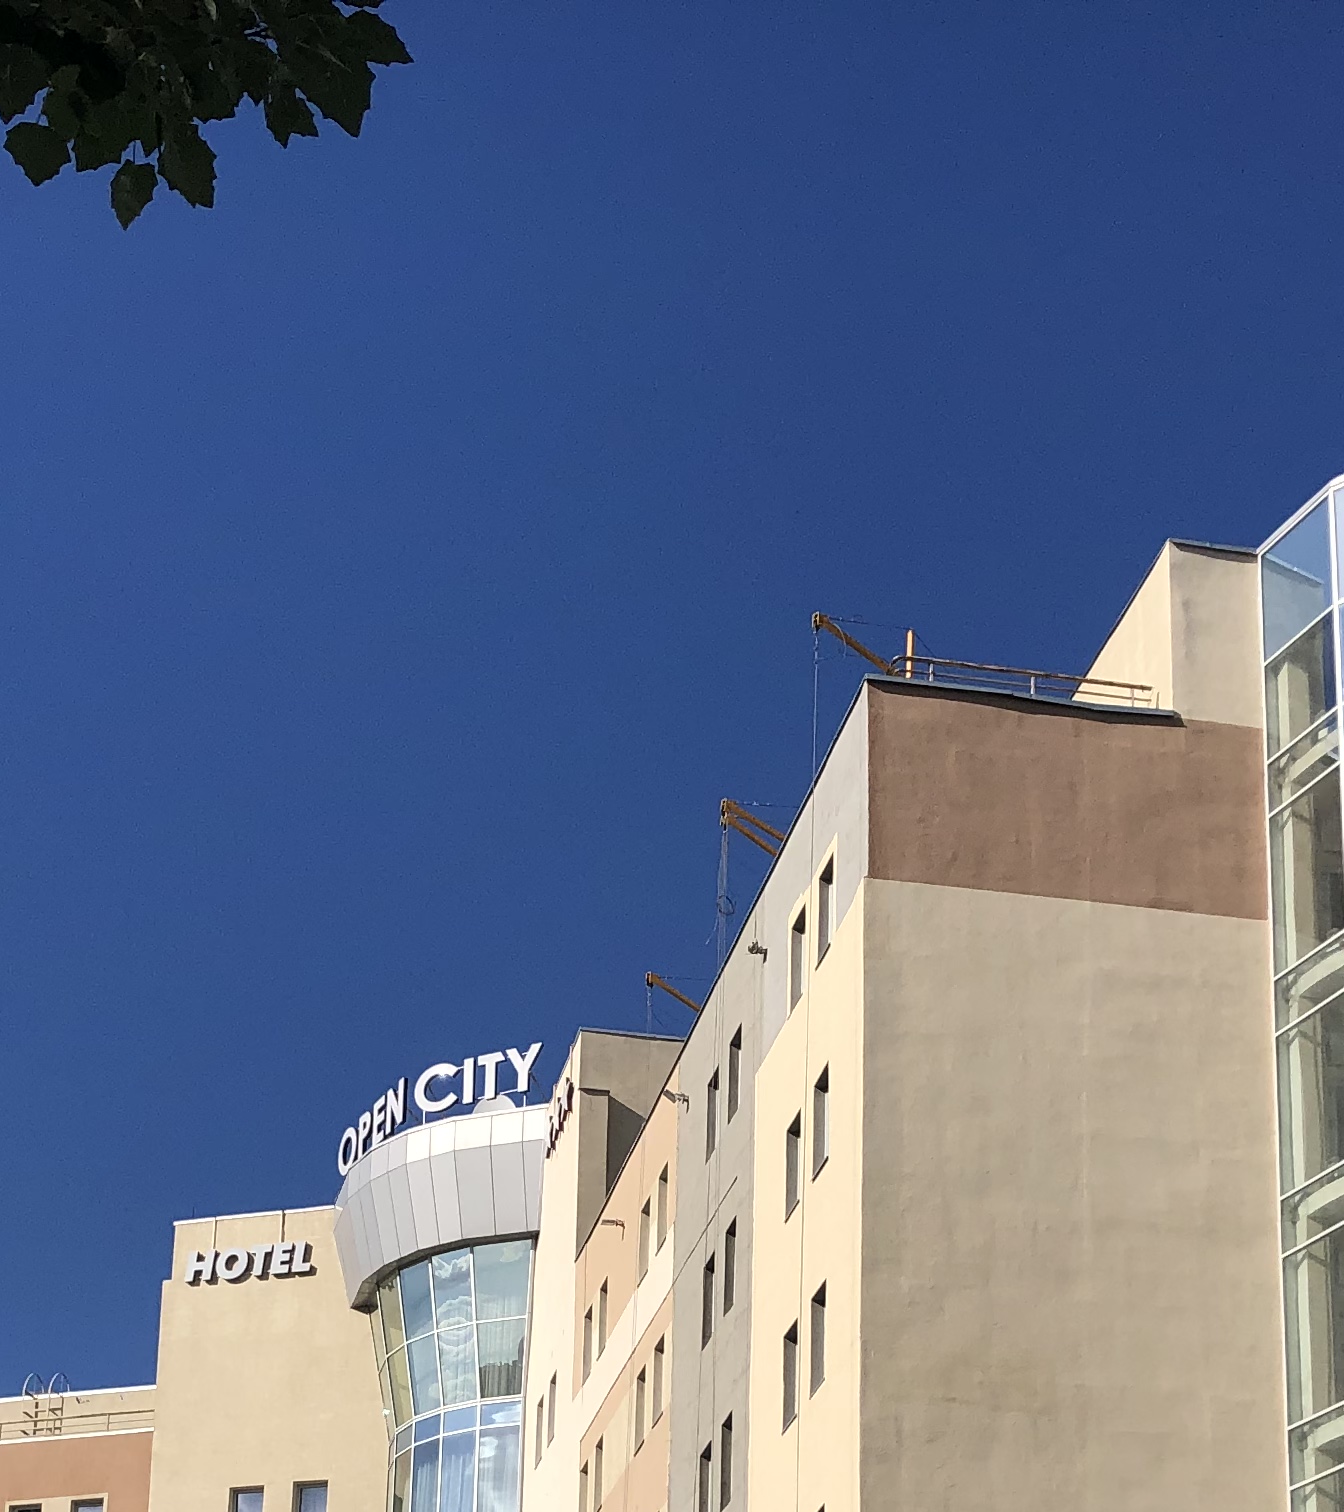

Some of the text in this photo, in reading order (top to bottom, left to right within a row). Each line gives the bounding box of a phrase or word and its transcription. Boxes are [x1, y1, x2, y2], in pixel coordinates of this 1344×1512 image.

[338, 1042, 544, 1176] OPEN CITY
[184, 1241, 317, 1287] HOTEL
